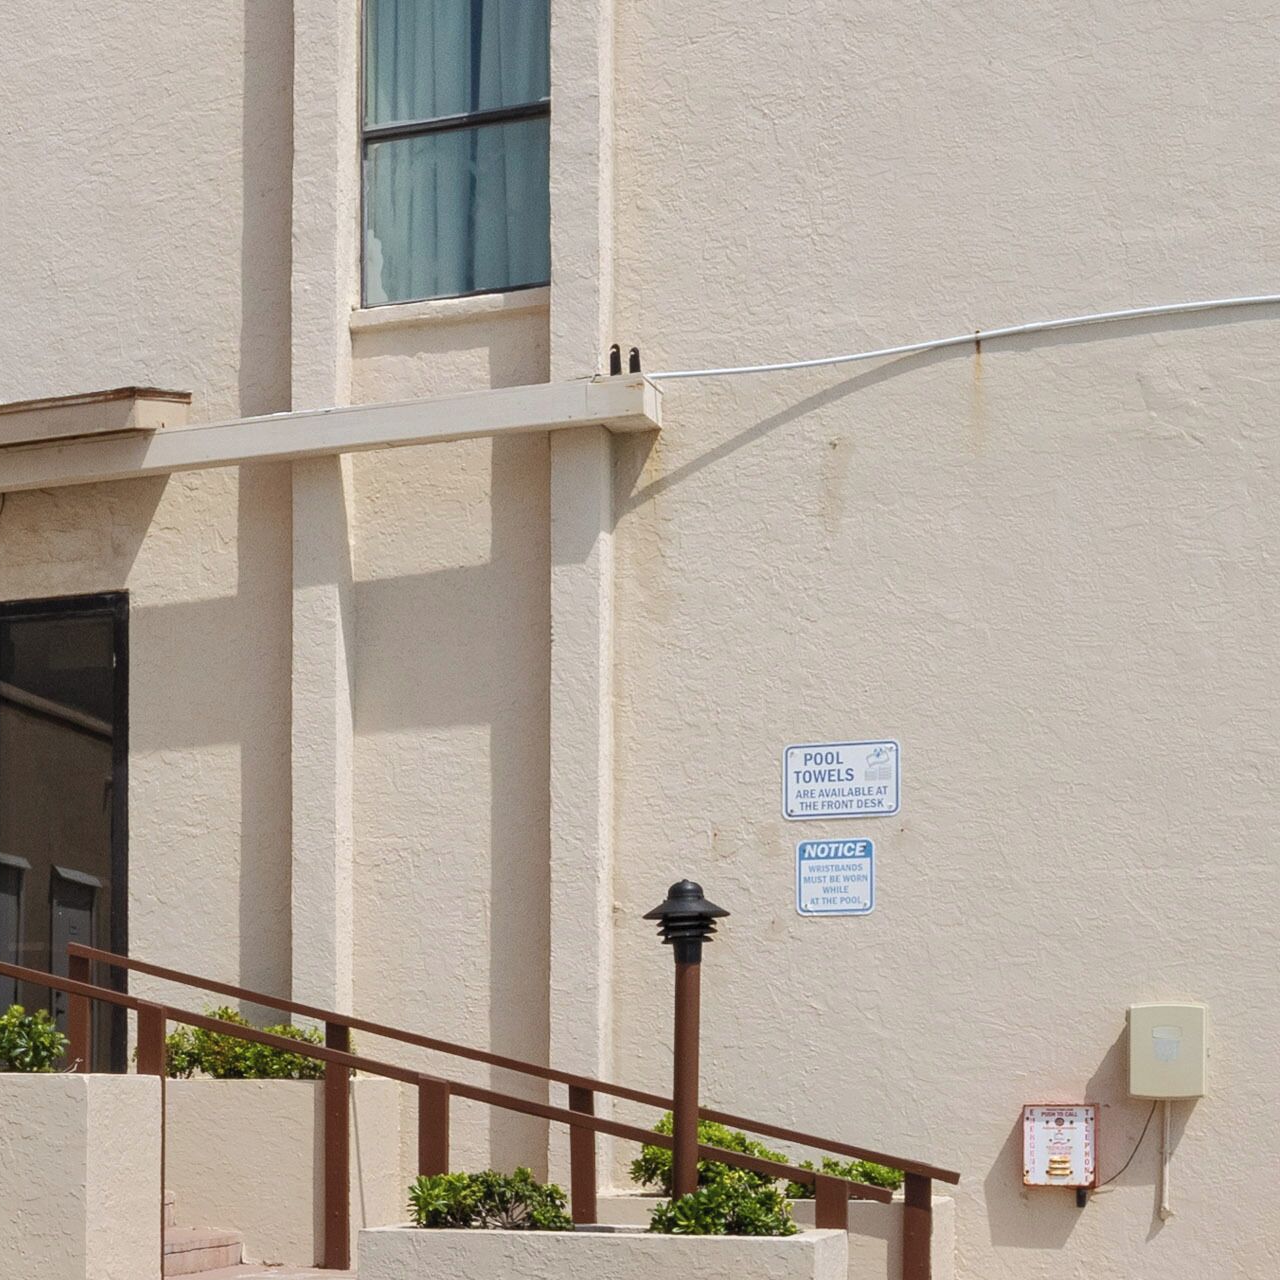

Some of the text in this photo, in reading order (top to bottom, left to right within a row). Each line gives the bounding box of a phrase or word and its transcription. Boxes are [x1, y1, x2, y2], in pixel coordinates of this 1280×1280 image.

[804, 752, 844, 766] POOL
[794, 768, 854, 784] TOWELS
[796, 786, 888, 799] ARE AVAILABLE AT
[800, 798, 884, 811] THE FRONT DESK
[804, 842, 867, 858] NOTICE
[808, 863, 863, 872] WRISTBANDS
[803, 874, 868, 884] MUST BE WORN
[822, 886, 849, 894] WHILE
[810, 895, 862, 905] AT THE POOL
